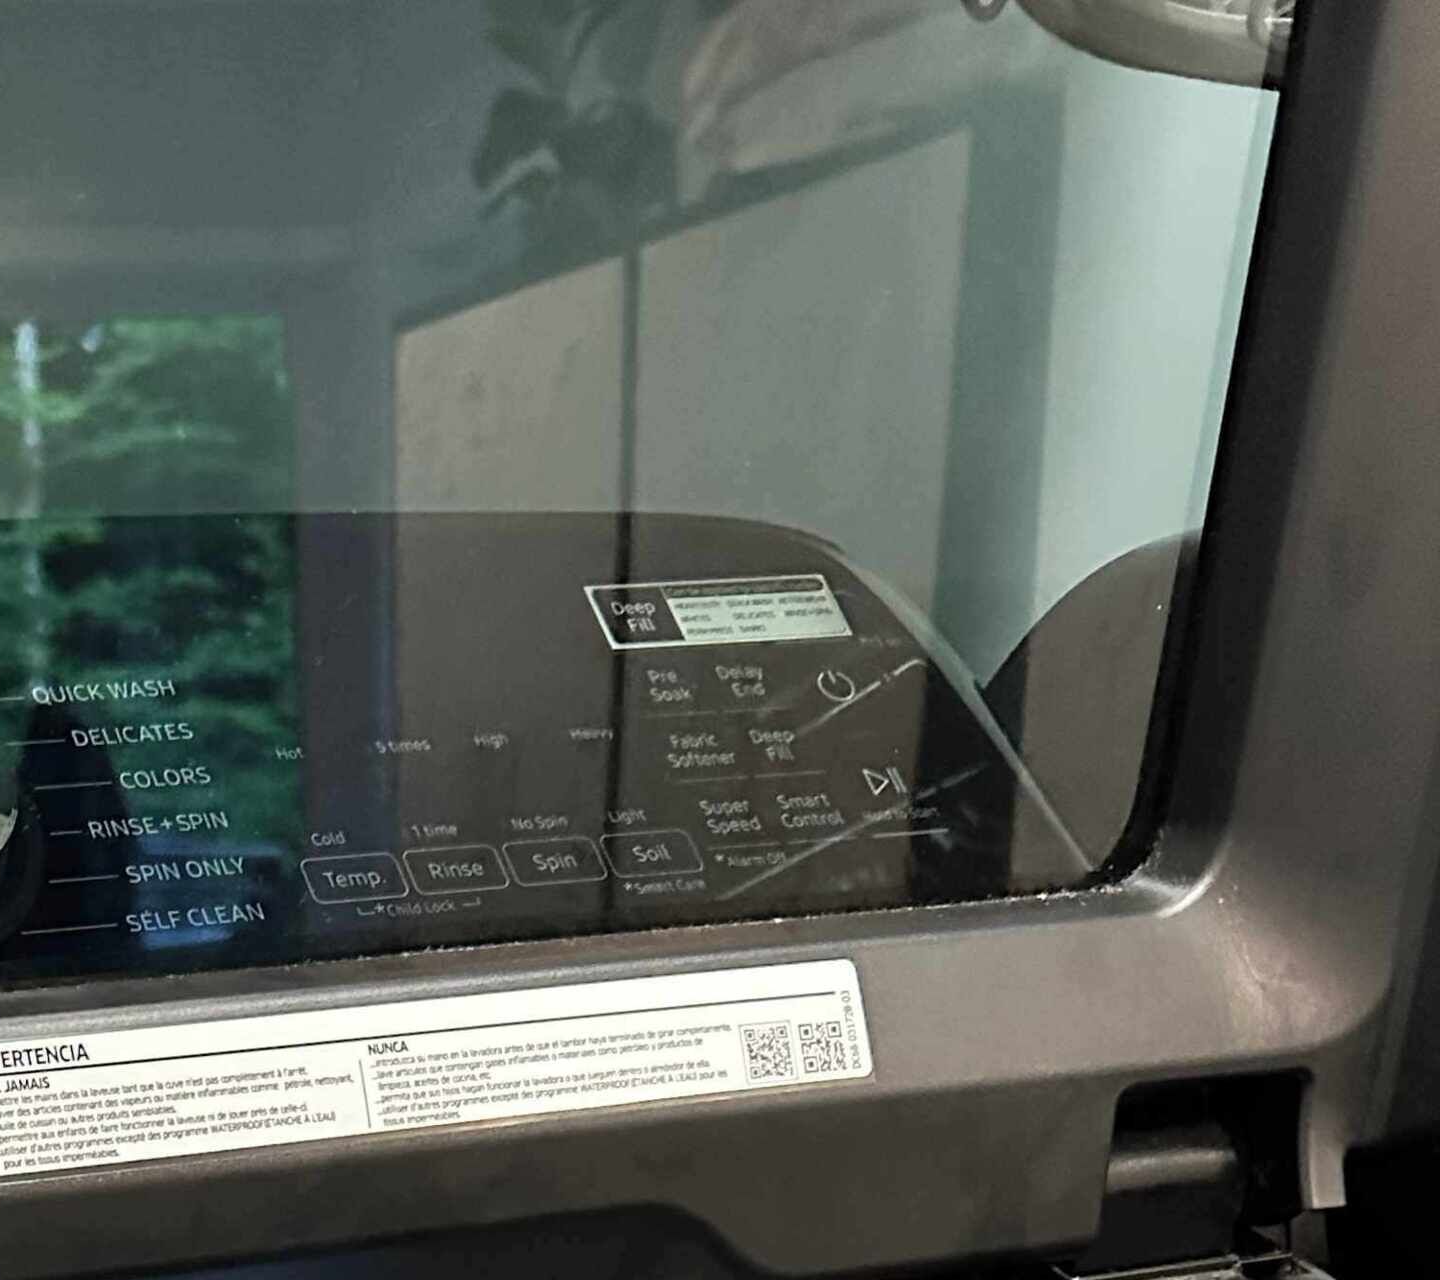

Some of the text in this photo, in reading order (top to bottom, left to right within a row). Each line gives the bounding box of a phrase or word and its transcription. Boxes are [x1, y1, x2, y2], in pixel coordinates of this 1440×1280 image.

[611, 602, 655, 615] Deep
[627, 617, 656, 632] Fill
[647, 669, 676, 684] Pre
[715, 666, 763, 683] Delay
[31, 680, 176, 705] QUICK WASH
[649, 687, 689, 701] Soak
[731, 683, 765, 698] End
[71, 722, 194, 747] DELICATES
[669, 734, 717, 748] Fabric
[749, 730, 795, 747] Deep
[275, 747, 304, 760] Hot
[667, 752, 735, 768] Softener
[765, 746, 794, 760] Fill
[119, 766, 211, 790] COLORS
[699, 800, 749, 817] Super
[776, 794, 830, 810] Smart
[706, 816, 761, 834] Speed
[781, 811, 844, 827] Control
[311, 831, 346, 846] Cold
[632, 844, 672, 862] Soil
[125, 857, 244, 885] SPIN ONLY
[428, 862, 484, 880] Rinse
[532, 853, 578, 873] Spin
[322, 870, 388, 890] Temp.
[126, 902, 266, 933] SELF CLEAN
[367, 1040, 409, 1056] NUNCA
[4, 1076, 50, 1093] JAMAIS
